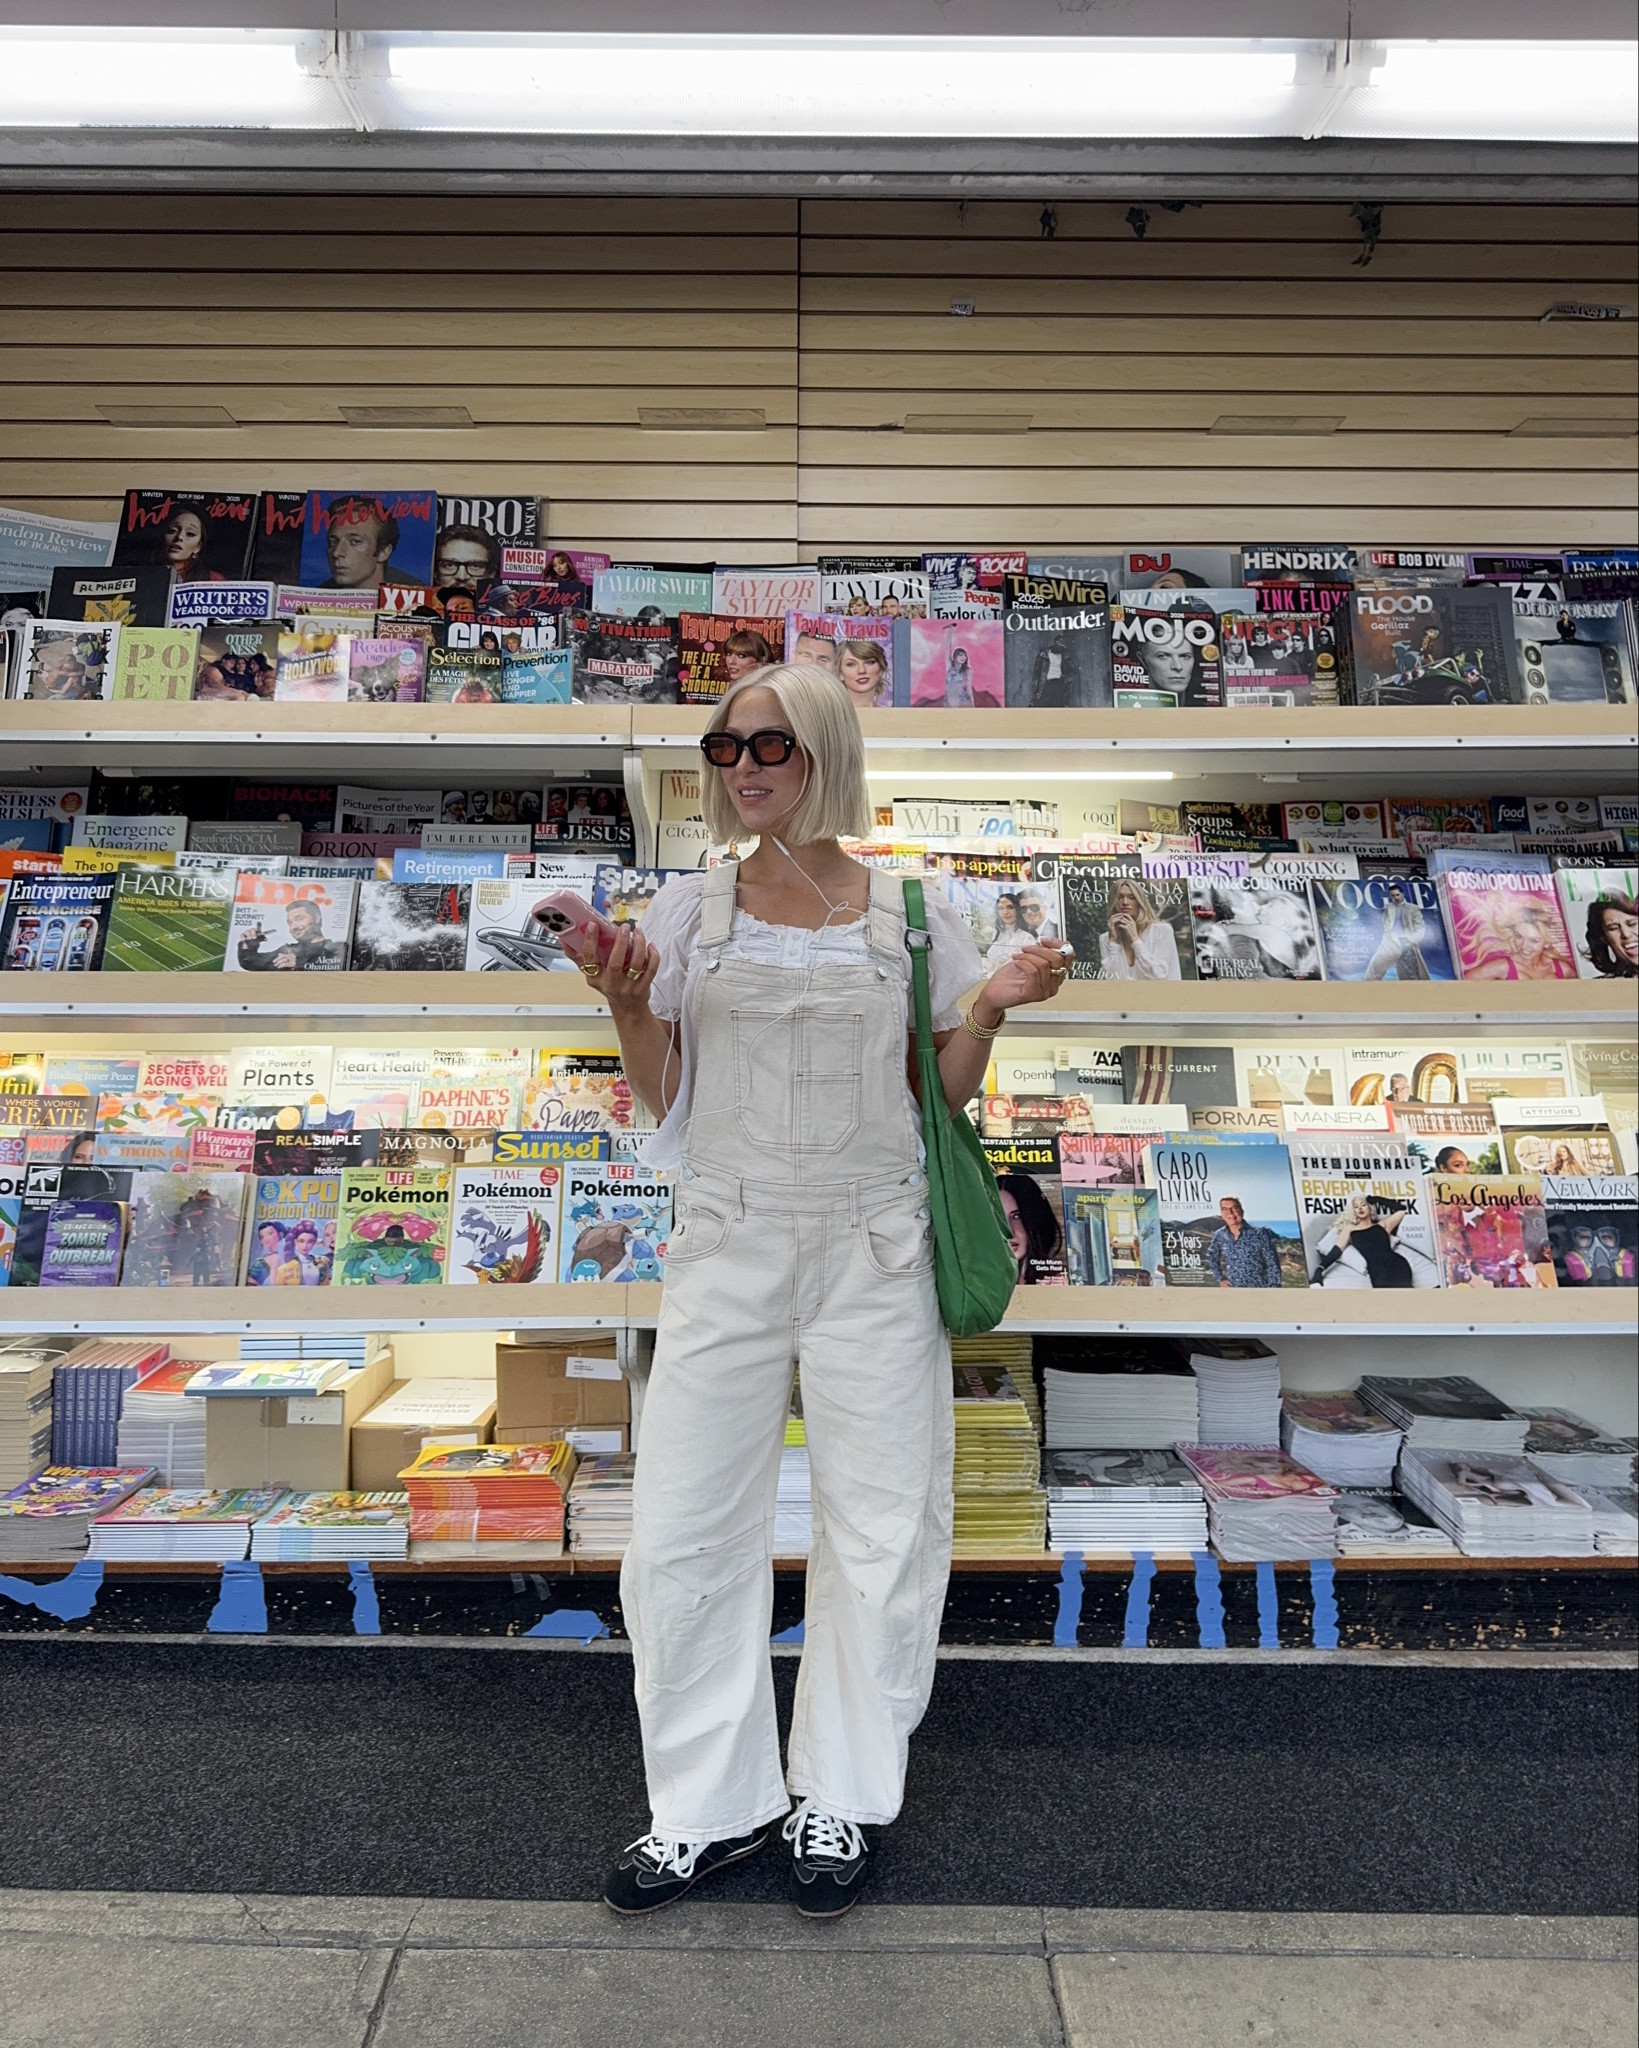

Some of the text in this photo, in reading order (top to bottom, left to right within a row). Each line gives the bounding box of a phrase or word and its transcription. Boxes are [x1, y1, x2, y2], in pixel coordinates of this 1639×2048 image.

[313, 493, 432, 535] Interview
[31, 542, 68, 554] BOOKS
[48, 533, 107, 553] Review
[504, 550, 544, 564] MUSIC
[1130, 554, 1171, 572] DJ
[1244, 552, 1347, 570] HENDRIX
[1371, 554, 1464, 568] LIFE BOB DYLAN
[504, 564, 544, 573] CONNECTION
[926, 558, 956, 572] VIVE
[980, 556, 1024, 573] ROCK!
[1506, 560, 1533, 569] TIME
[79, 580, 135, 593] ALPHABET
[597, 575, 710, 596] TAYLOR SWIFT
[720, 579, 814, 598] TAYLOR
[826, 578, 924, 600] TAYLOR
[176, 590, 267, 606] WRITER'S
[964, 592, 1000, 606] People
[1018, 593, 1044, 604] 2025
[174, 604, 264, 616] YEARBOOK 2026
[1357, 596, 1433, 615] FLOOD
[449, 613, 518, 626] THE CLASS
[794, 614, 888, 637] Taylor Travis
[681, 614, 731, 642] Taylor
[1112, 616, 1216, 649] MOJO
[226, 634, 262, 646] OTHER
[229, 644, 258, 656] NESS
[503, 652, 568, 670] Prevention
[682, 650, 720, 666] THE LIFE
[591, 662, 650, 676] MARATHON
[690, 666, 710, 678] OF A
[1114, 665, 1144, 674] DAVID
[503, 676, 536, 687] LONGER
[624, 676, 654, 686] Burger
[1114, 674, 1150, 684] BOWIE
[502, 690, 536, 699] HAPPIER
[234, 788, 333, 801] BIOHACK
[342, 799, 436, 813] Pictures of the Year
[1498, 804, 1525, 822] food
[1188, 814, 1234, 828] Soups
[83, 821, 176, 839] Emergence
[536, 824, 558, 834] LIFE
[563, 826, 631, 842] JESUS
[1257, 826, 1272, 836] 83
[308, 842, 376, 858] ORION
[1318, 844, 1388, 854] what to eat
[75, 860, 114, 872] The 10
[290, 866, 374, 880] RETIREMENT
[404, 859, 493, 876] Retirement
[540, 862, 566, 874] New
[936, 856, 1023, 876] bon appétit
[1037, 860, 1141, 879] Chocolate
[1262, 862, 1346, 875] COOKING
[234, 872, 333, 906] Inc.
[1449, 872, 1555, 892] COSMOPOLITAN
[10, 880, 114, 902] Entrepreneur
[480, 890, 510, 898] BUSINESS
[118, 897, 198, 908] AMERICA GOES FOR
[479, 898, 504, 906] REVIEW
[1155, 895, 1184, 905] DAY
[16, 906, 102, 916] FRANCHISE
[304, 962, 340, 971] Ohanian
[316, 956, 340, 965] Alexis
[300, 1058, 312, 1068] of
[1580, 1050, 1619, 1064] Living
[148, 1064, 228, 1076] SECRETS OF
[336, 1060, 430, 1072] Heart Health
[1144, 1064, 1218, 1073] THE CURRENT
[111, 1072, 136, 1082] Peace
[144, 1076, 228, 1087] AGING WELL
[243, 1070, 315, 1086] Plants
[6, 1098, 80, 1108] WHERE WOMEN
[421, 1089, 510, 1107] DAPHNE'S
[218, 1108, 277, 1130] flow
[453, 1110, 508, 1127] DIARY
[540, 1100, 601, 1130] Paper
[1294, 1112, 1378, 1124] MANERA
[1400, 1114, 1490, 1134] MODERN RUSTIC
[196, 1130, 254, 1147] Woman's
[276, 1134, 362, 1146] REAL SIMPLE
[384, 1136, 488, 1150] MAGNOLIA
[1060, 1132, 1103, 1153] Santa
[209, 1145, 250, 1160] World
[495, 1134, 608, 1162] Sunset
[1156, 1150, 1208, 1180] CABO
[1301, 1157, 1411, 1170] THE JOURNAL
[386, 1172, 414, 1184] LIFE
[493, 1169, 524, 1180] TIME
[608, 1166, 634, 1178] LIFE
[347, 1187, 449, 1203] Pokémon
[462, 1183, 552, 1198] Pokémon
[571, 1181, 669, 1198] Pokémon
[1159, 1180, 1212, 1202] LIVING
[1372, 1180, 1416, 1197] HILLS
[1584, 1178, 1638, 1200] YORK
[1077, 1194, 1146, 1204] apartamento
[1435, 1182, 1545, 1212] Los Angeles
[258, 1204, 302, 1220] Demon
[60, 1232, 108, 1247] ZOMBIE
[1165, 1231, 1202, 1250] 25 Years
[50, 1250, 116, 1266] OUTBREAK
[1182, 1250, 1201, 1267] Baja
